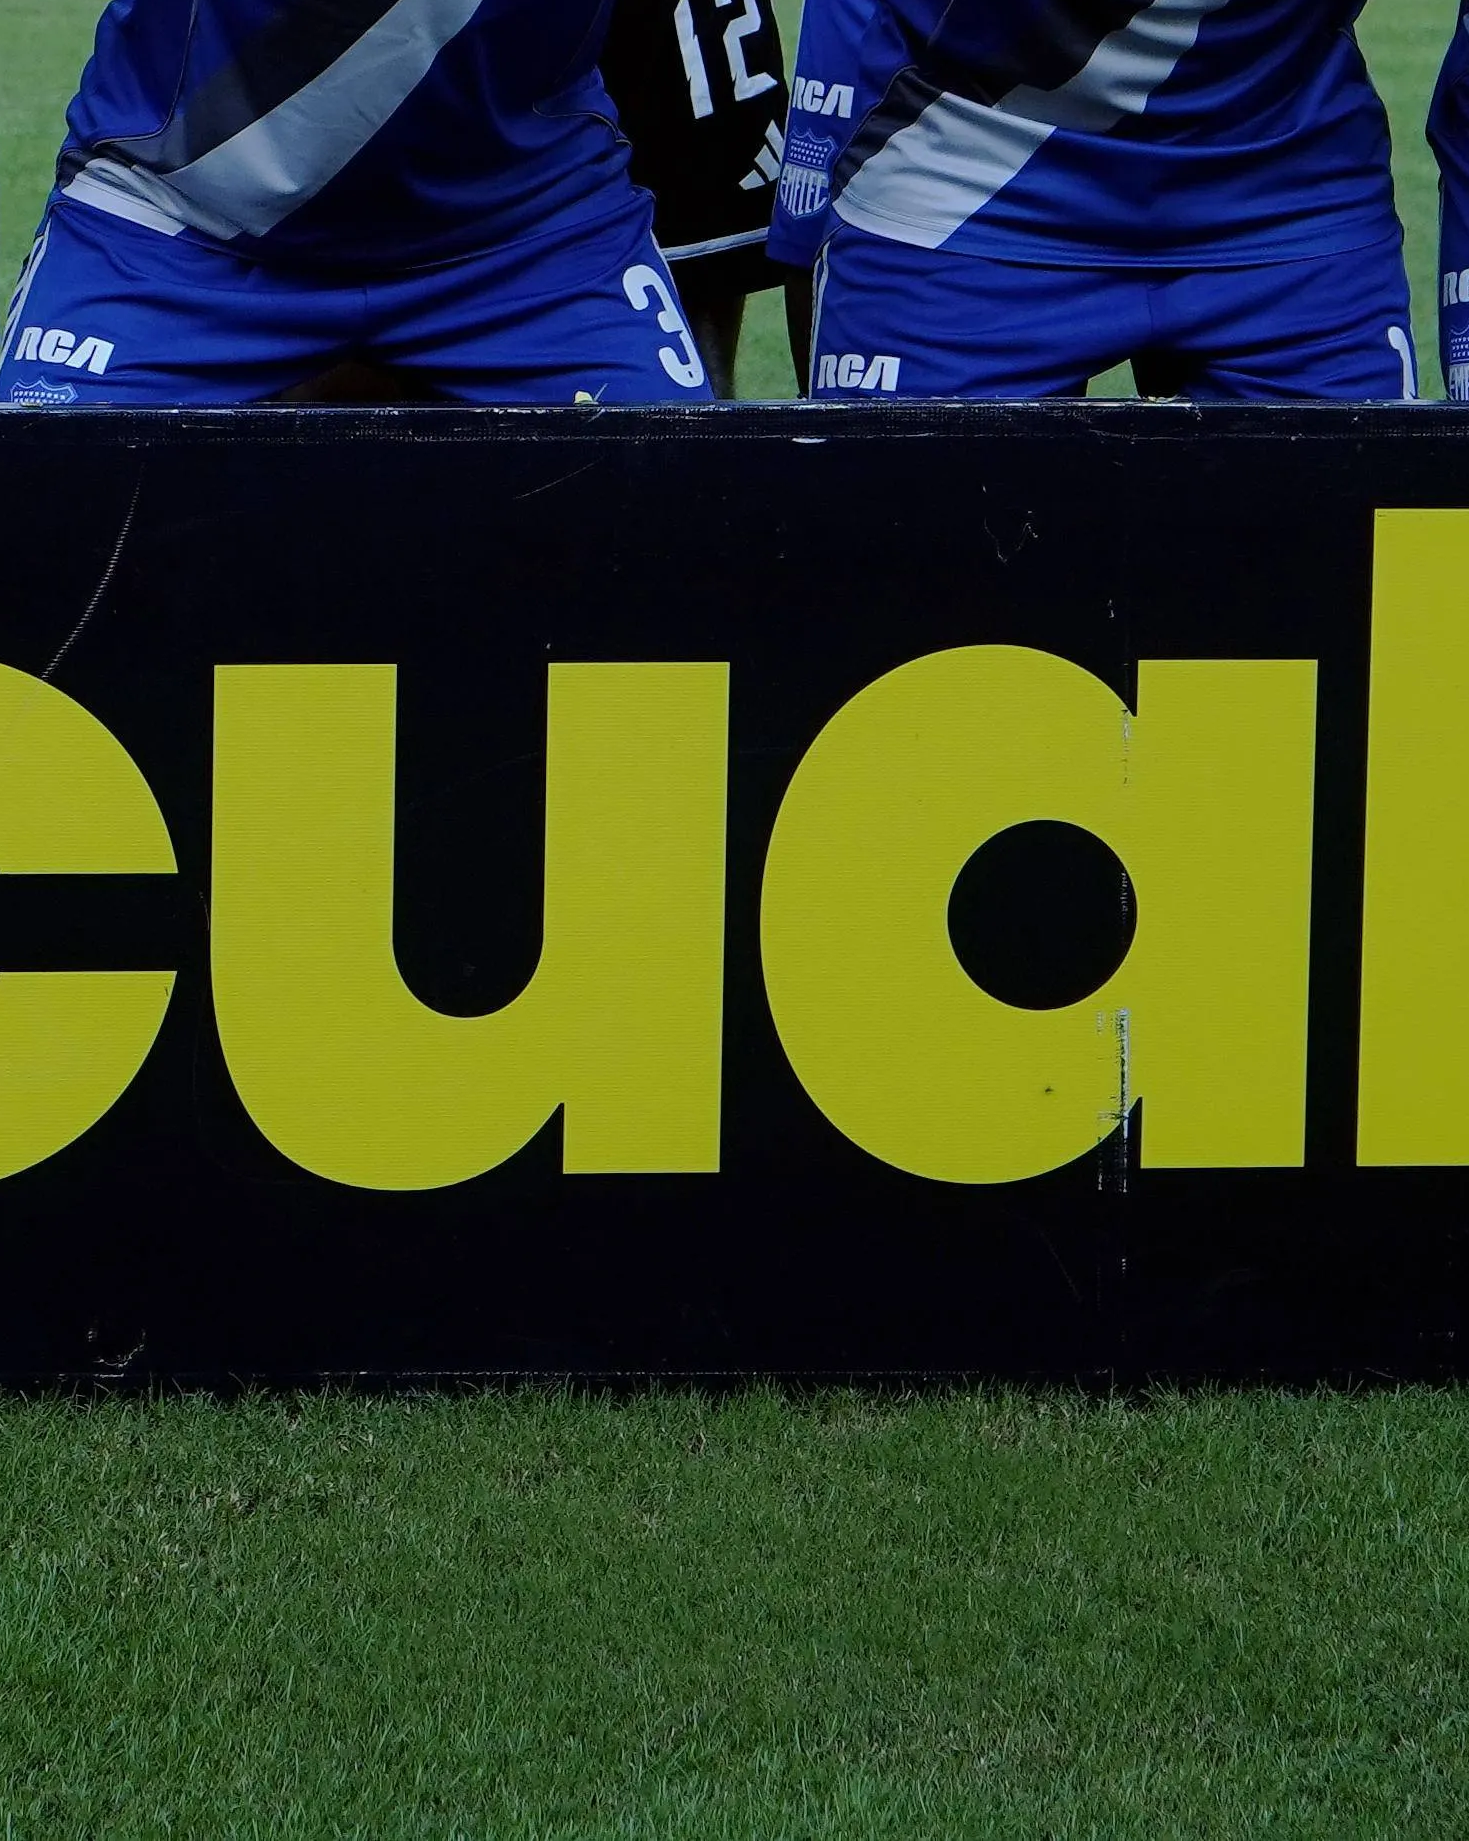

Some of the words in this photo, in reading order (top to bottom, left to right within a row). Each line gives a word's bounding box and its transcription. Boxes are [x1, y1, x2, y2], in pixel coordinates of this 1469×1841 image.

[791, 76, 855, 119] RCA
[15, 325, 115, 377] RCA
[817, 353, 901, 392] RCA
